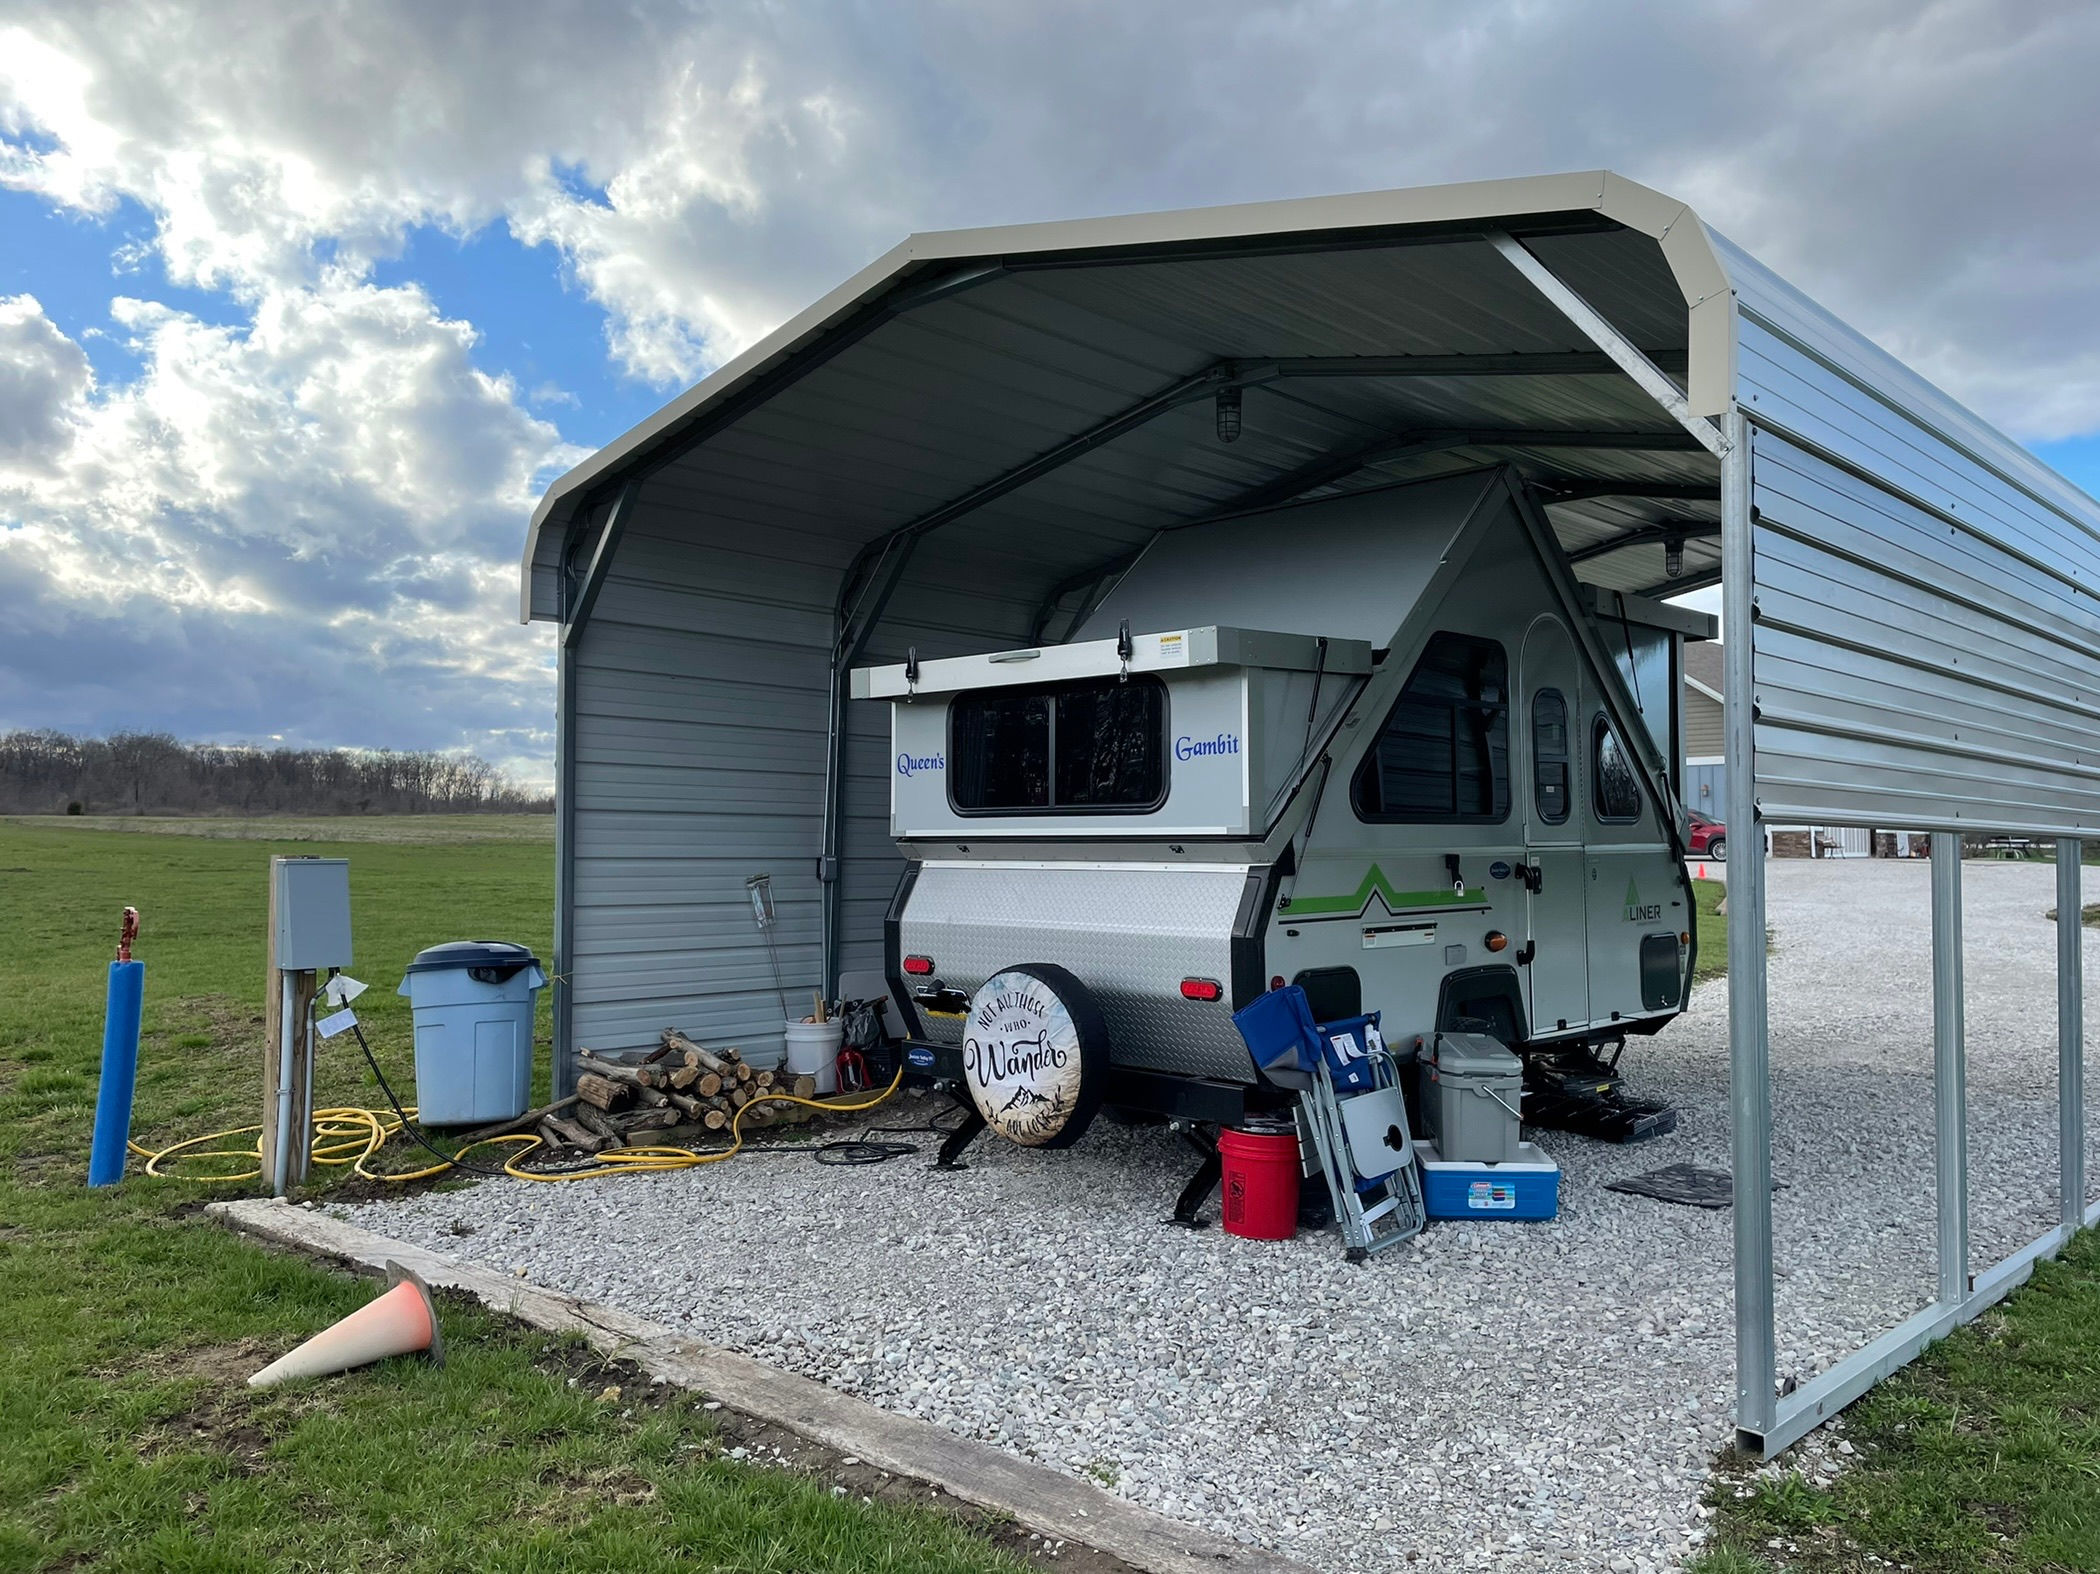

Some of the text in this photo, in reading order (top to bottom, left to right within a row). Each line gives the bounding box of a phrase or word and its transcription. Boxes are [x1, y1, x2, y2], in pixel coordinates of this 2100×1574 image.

[897, 733, 1239, 778] Queen's Gambit
[978, 991, 1045, 1031] NOT ALL THOSE
[1004, 1019, 1027, 1033] WHO
[963, 1029, 1067, 1088] Wander
